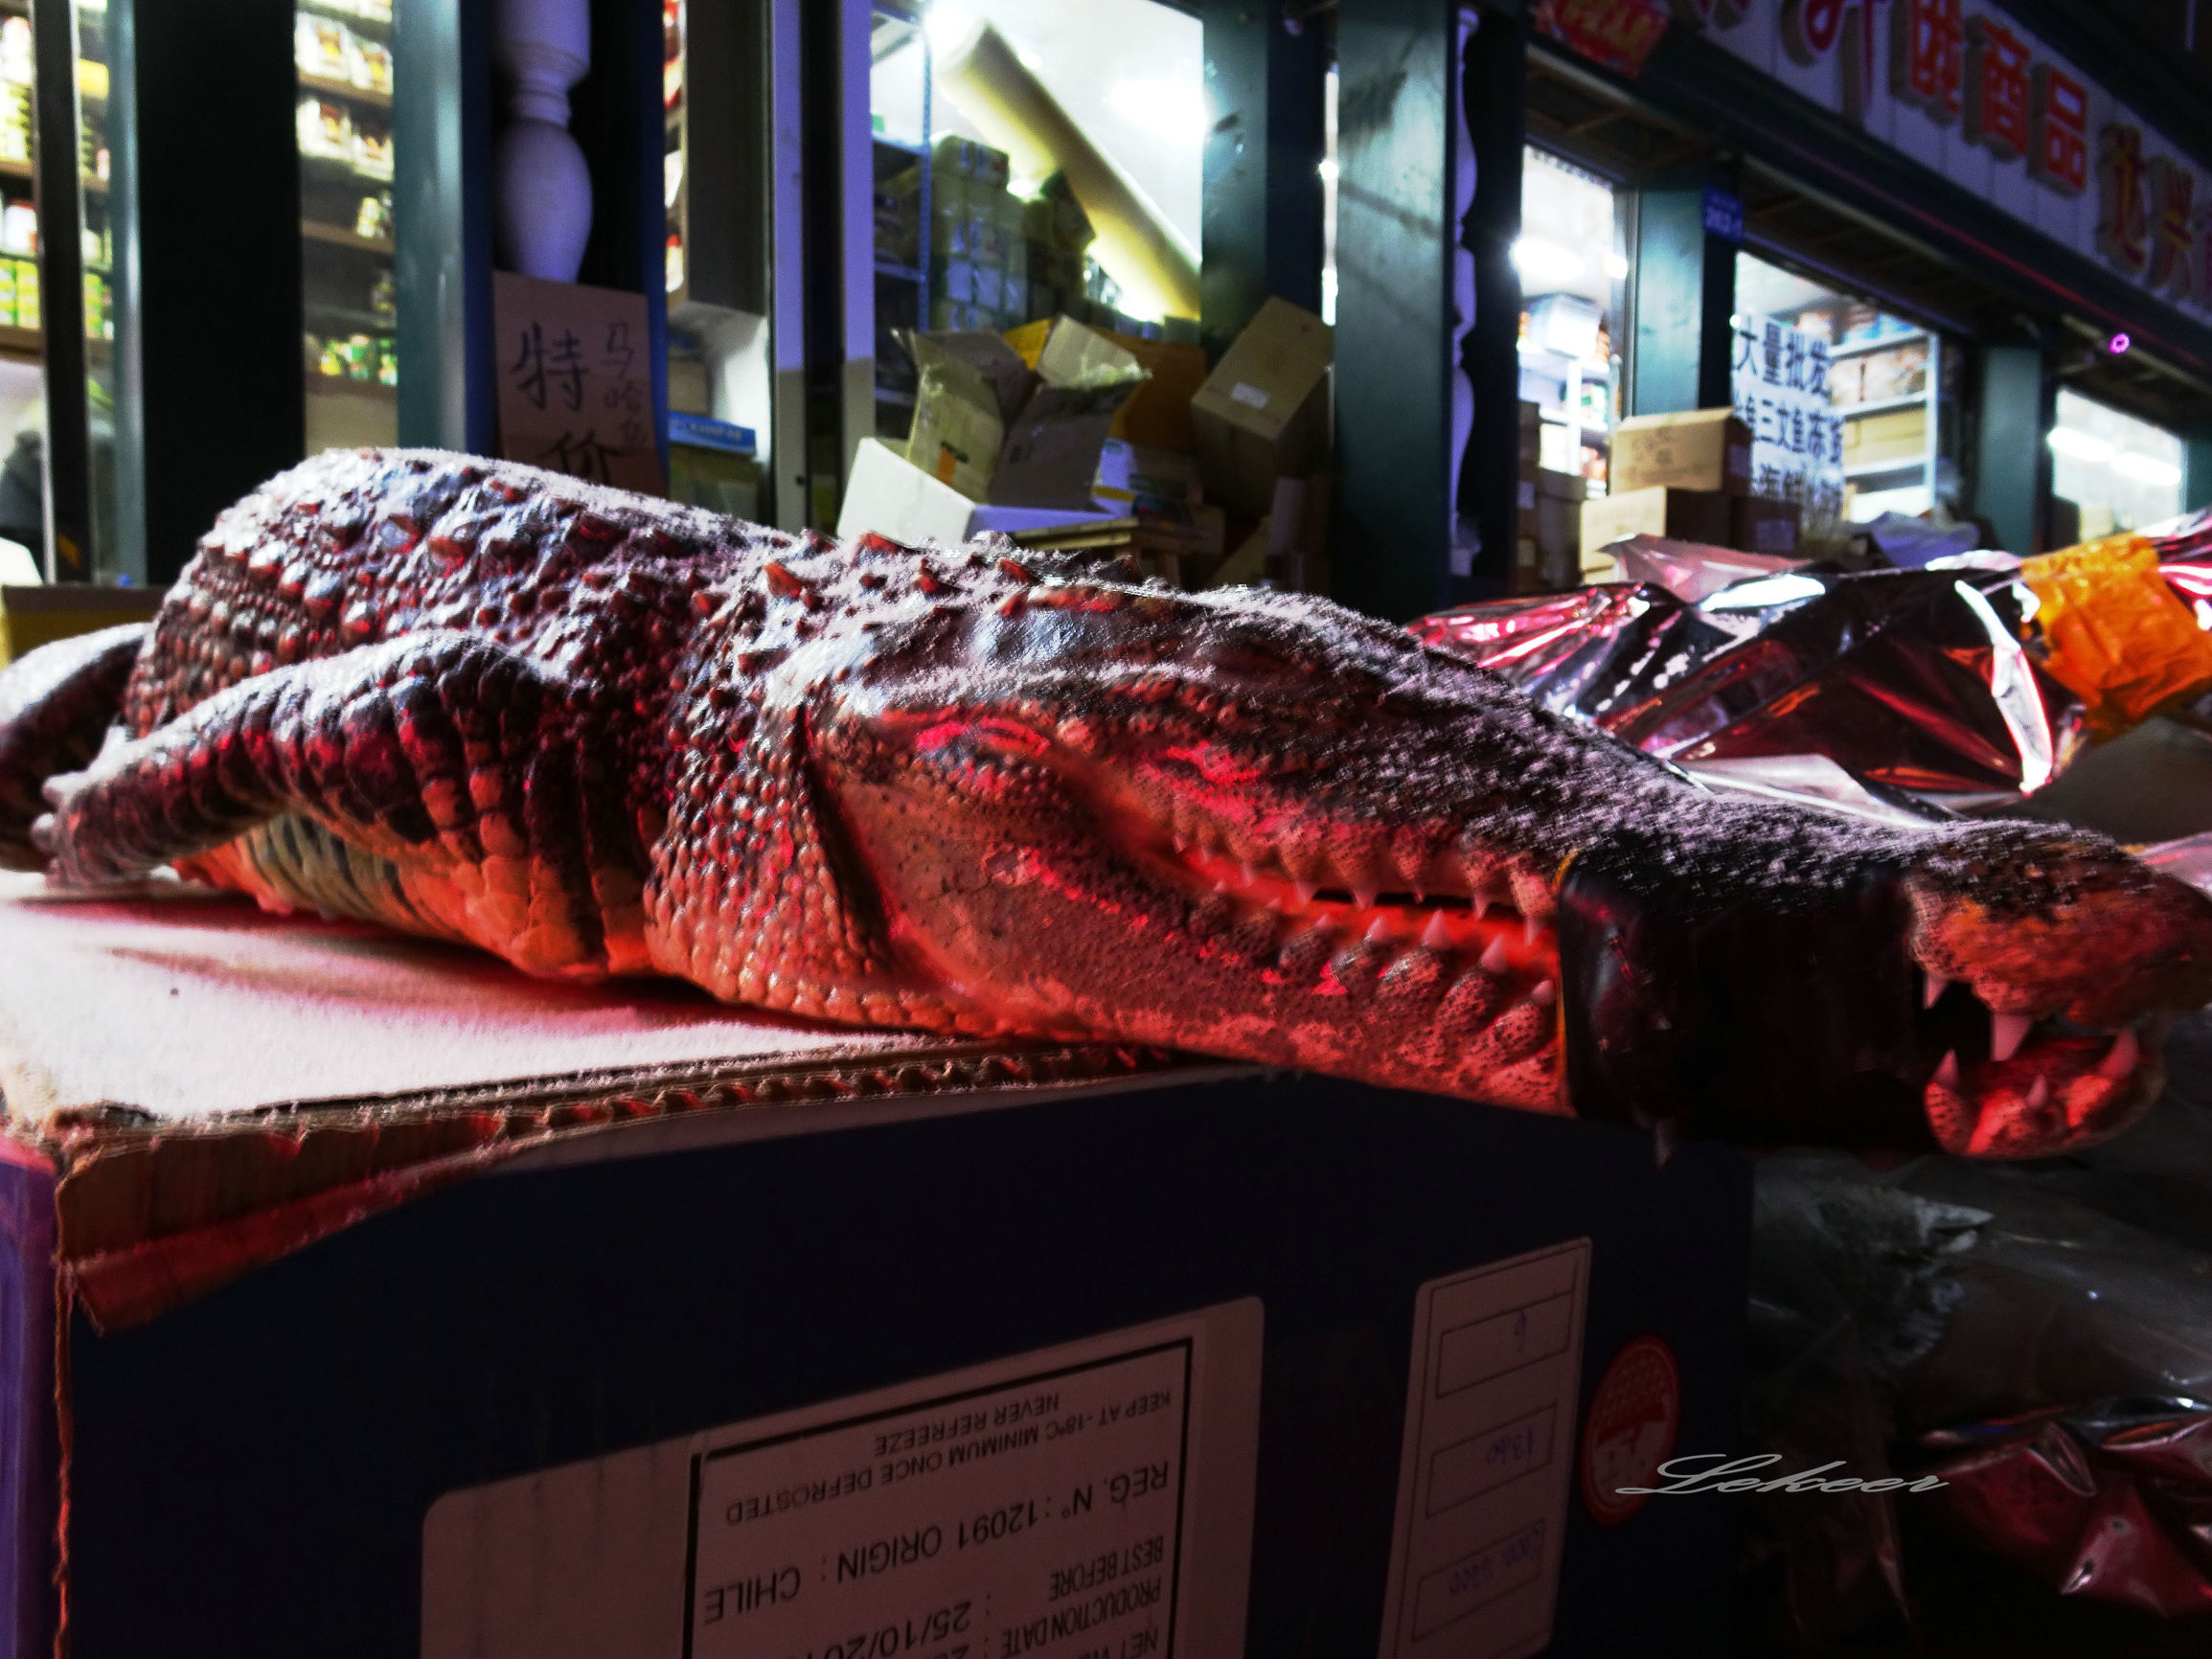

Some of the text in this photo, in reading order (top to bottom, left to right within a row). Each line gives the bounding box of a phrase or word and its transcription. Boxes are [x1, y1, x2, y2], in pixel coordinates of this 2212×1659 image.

[874, 1393, 1060, 1457] NEVER REFREEZE
[1098, 1403, 1122, 1426] AT
[1125, 1390, 1172, 1419] KEEP
[879, 1449, 944, 1486] ONCE
[948, 1425, 1039, 1466] MINIMUM
[725, 1466, 873, 1526] DEFROSTED
[1104, 1460, 1170, 1505] REG.
[837, 1525, 942, 1585] ORIGIN
[1048, 1551, 1119, 1602] BEFORE
[1122, 1534, 1165, 1577] BEST
[704, 1565, 801, 1625] CHILE
[1051, 1576, 1162, 1642] PRODUCTION
[1002, 1616, 1049, 1658] DATE
